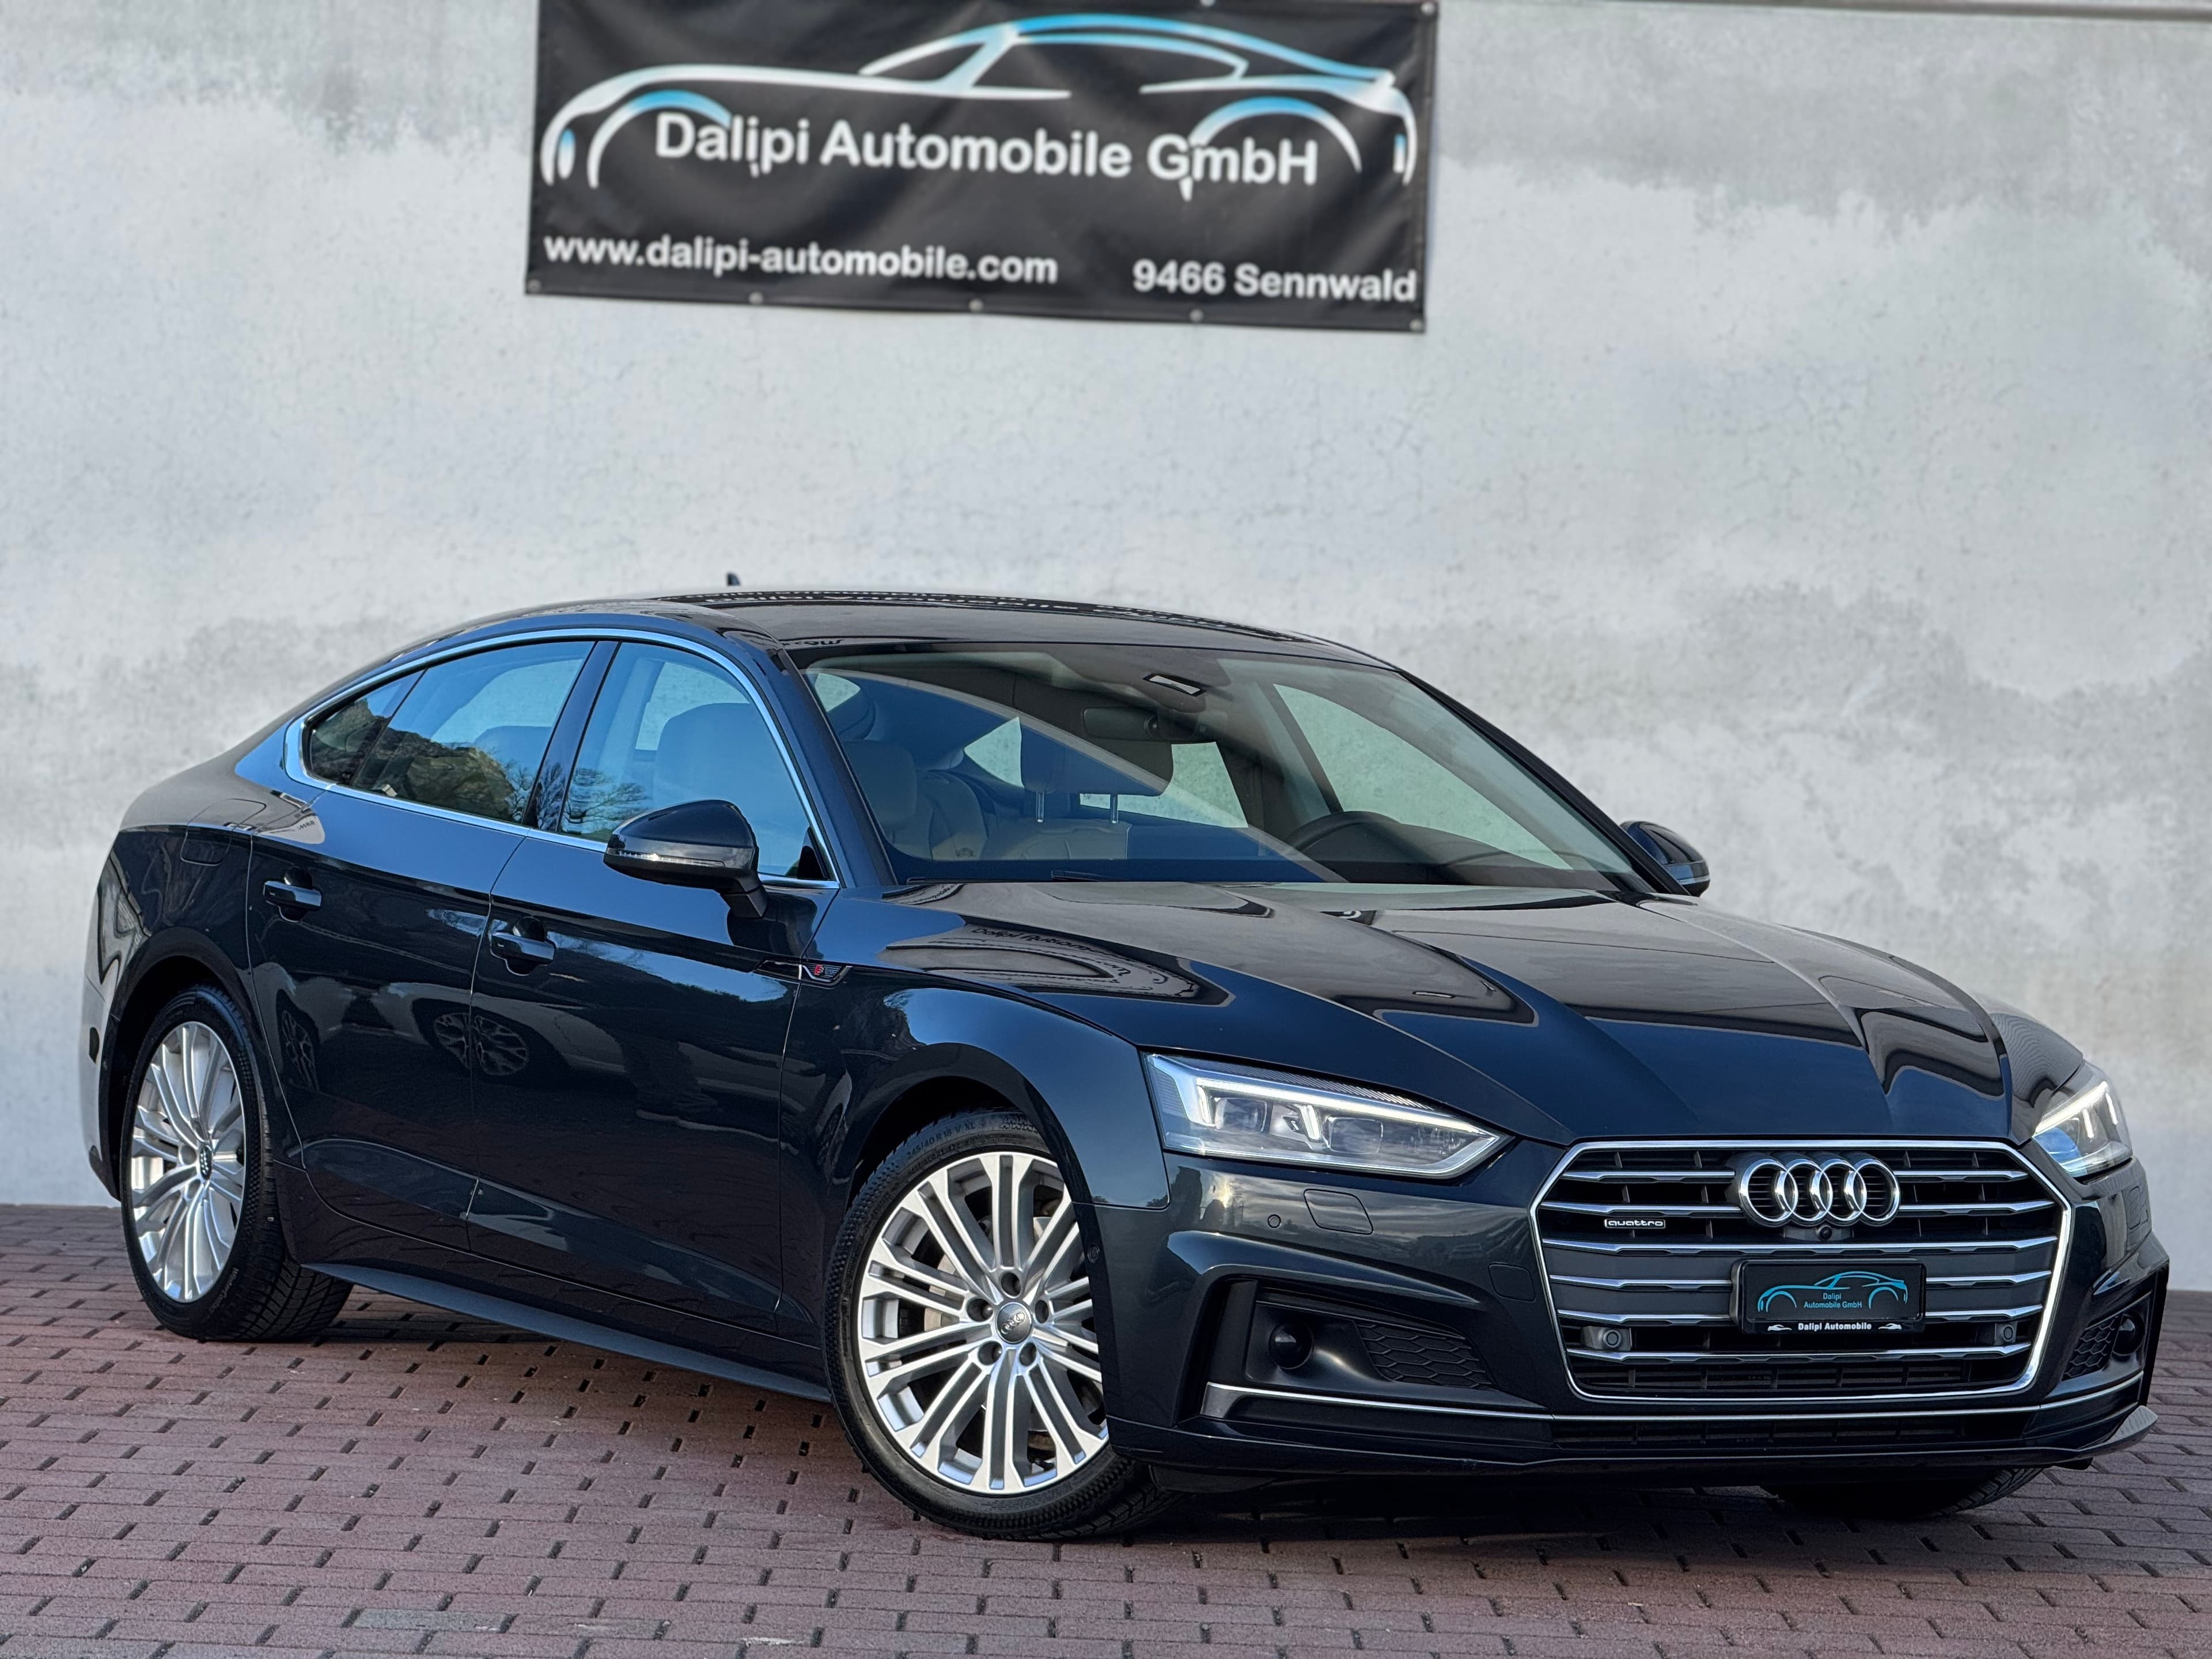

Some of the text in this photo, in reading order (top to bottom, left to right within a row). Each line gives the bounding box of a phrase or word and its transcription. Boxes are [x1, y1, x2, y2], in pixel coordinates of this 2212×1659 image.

[657, 114, 1318, 185] Dalipi Automobile GmbH
[544, 236, 1057, 283] www.dalipi-automobile.com
[1132, 259, 1416, 301] 9466 Sennwald
[1823, 1293, 1842, 1301] Dalipi
[1798, 1322, 1872, 1332] Dalipi Automobile
